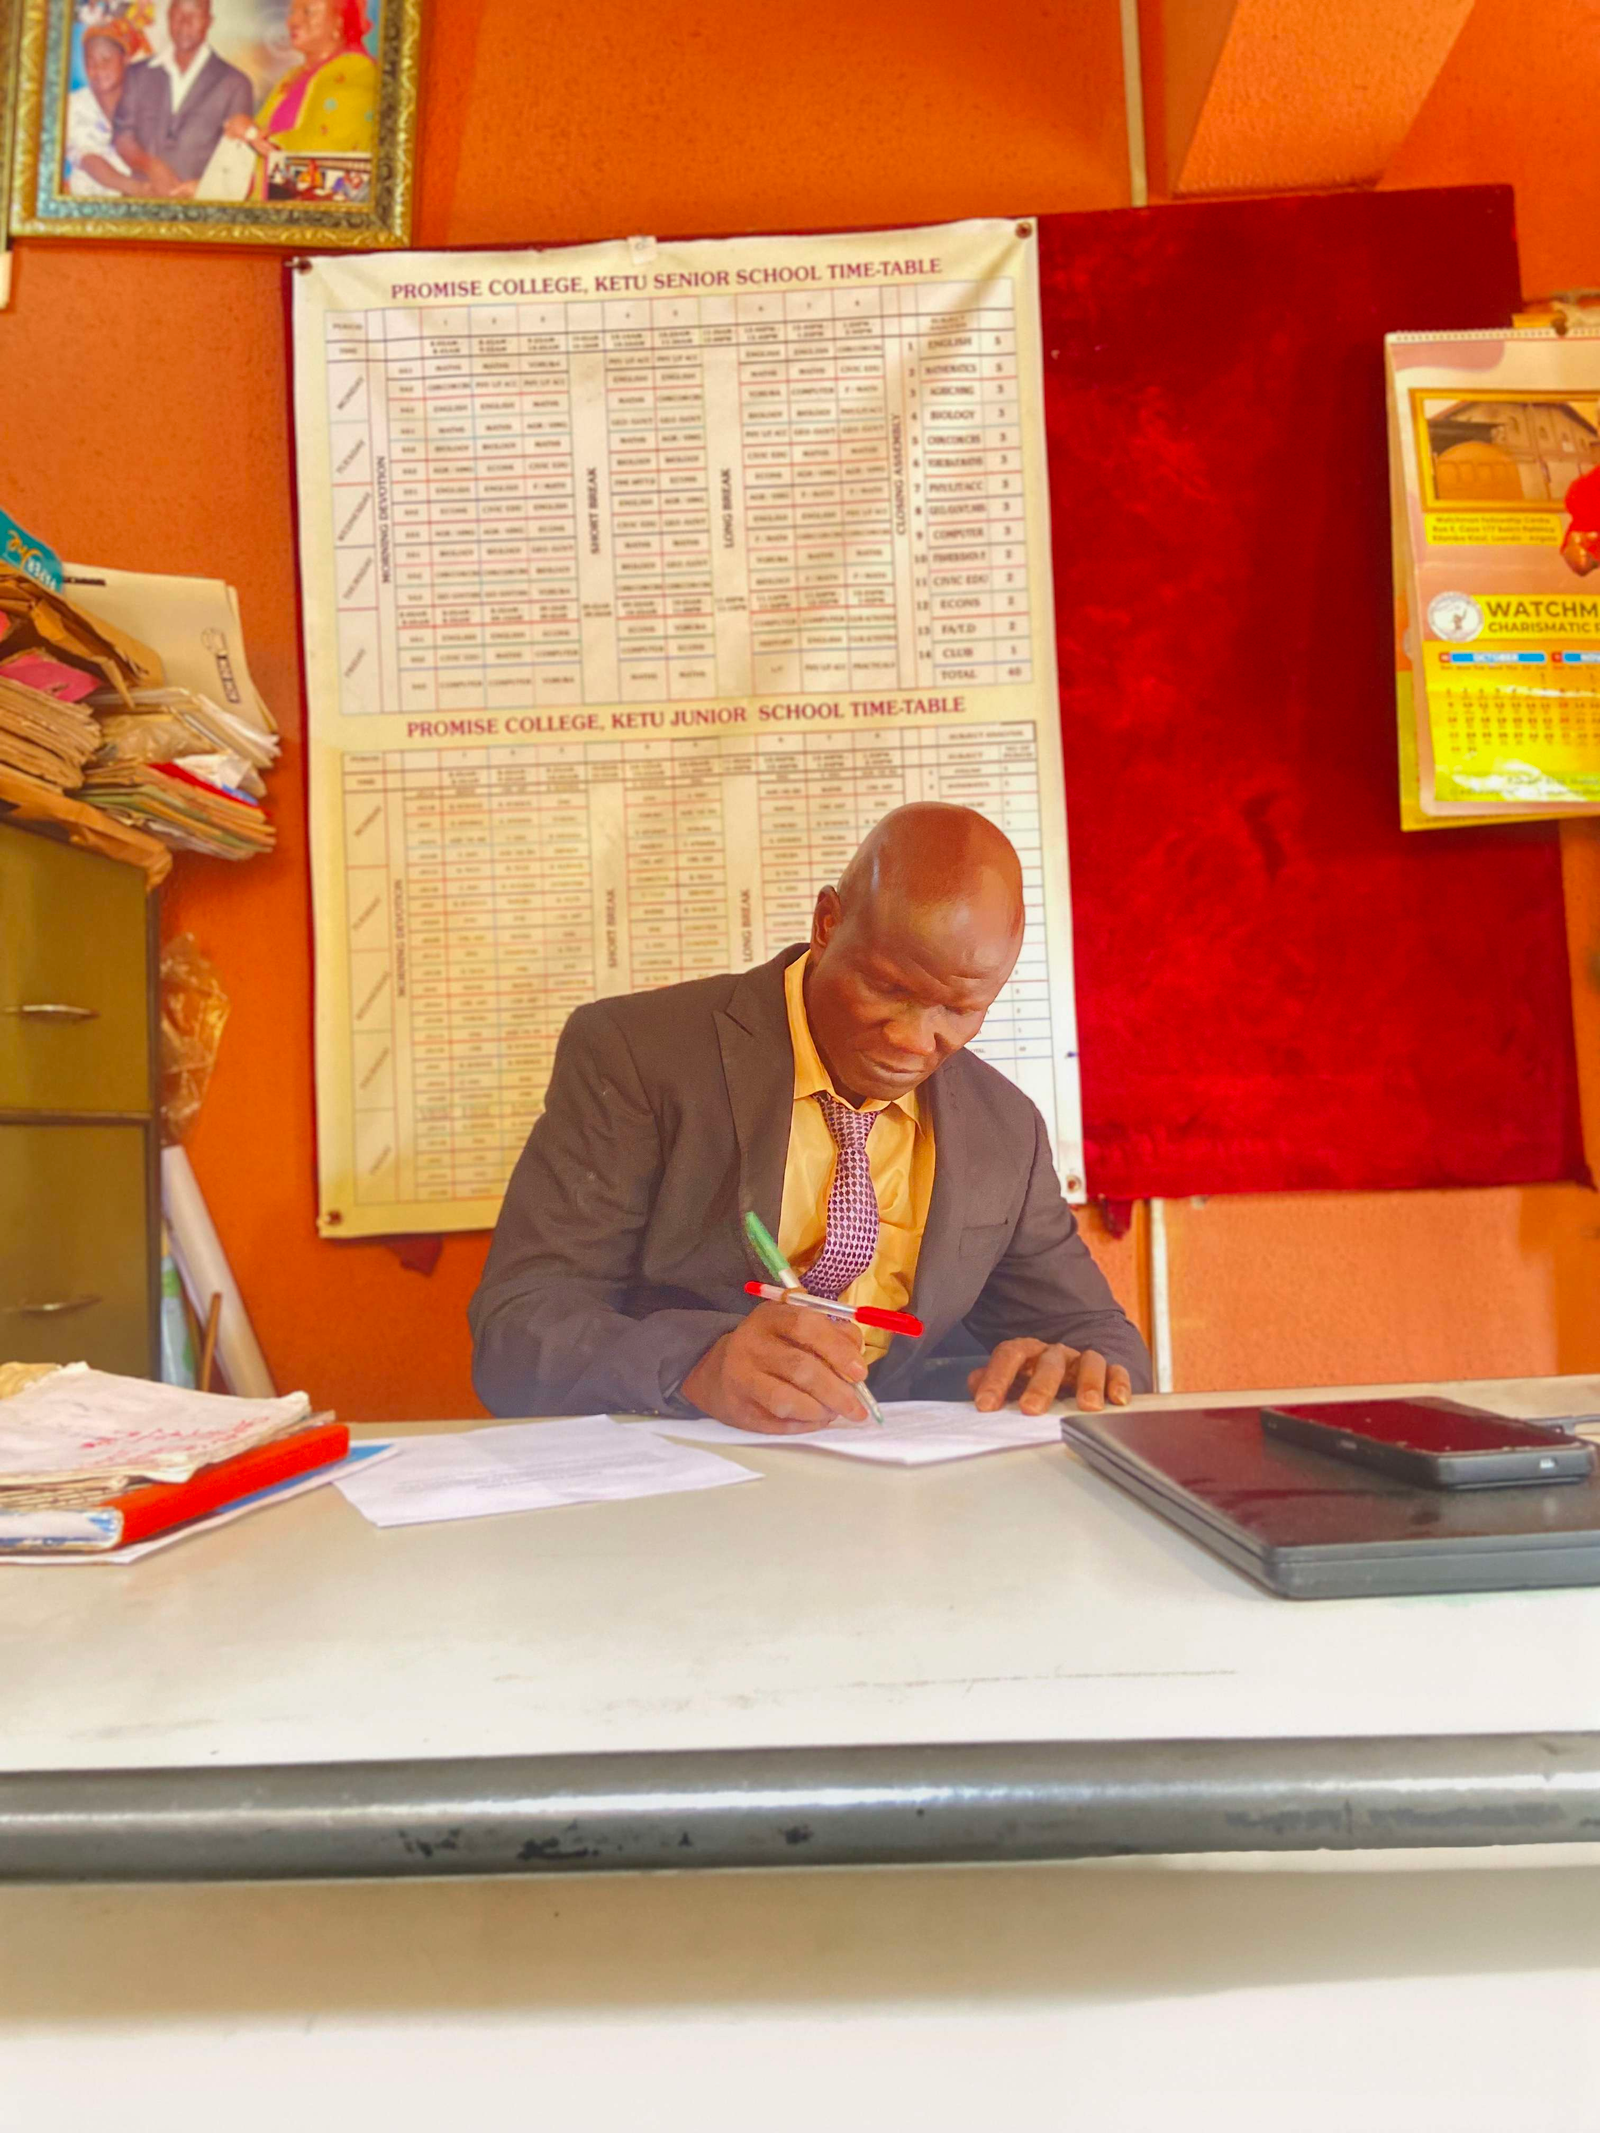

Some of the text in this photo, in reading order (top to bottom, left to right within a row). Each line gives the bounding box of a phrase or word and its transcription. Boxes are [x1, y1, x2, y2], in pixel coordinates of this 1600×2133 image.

[391, 258, 943, 299] PROMISE COLLEGE, KETU SENIOR SCHOOL TIME-TABLE
[928, 337, 972, 349] ENGLISH
[930, 408, 975, 420] BIOLOGY
[890, 413, 906, 536] CLOSING ASSEMBLY
[586, 467, 600, 554] SHORT BREAK
[721, 469, 735, 548] LONG BREAK
[376, 456, 391, 583] MORNING DEVOTION
[933, 528, 984, 540] COMPUTER
[940, 599, 981, 610] ECONS
[1485, 601, 1600, 618] WATCHM
[1488, 621, 1591, 634] CHARISMATIC
[942, 647, 974, 659] CLUB
[941, 670, 976, 681] TOTAL
[407, 696, 967, 738] PROMISE COLLEGE, KETU JUNIOR SCHOOL TIME-TABLE
[740, 889, 754, 962] LONG BREAK
